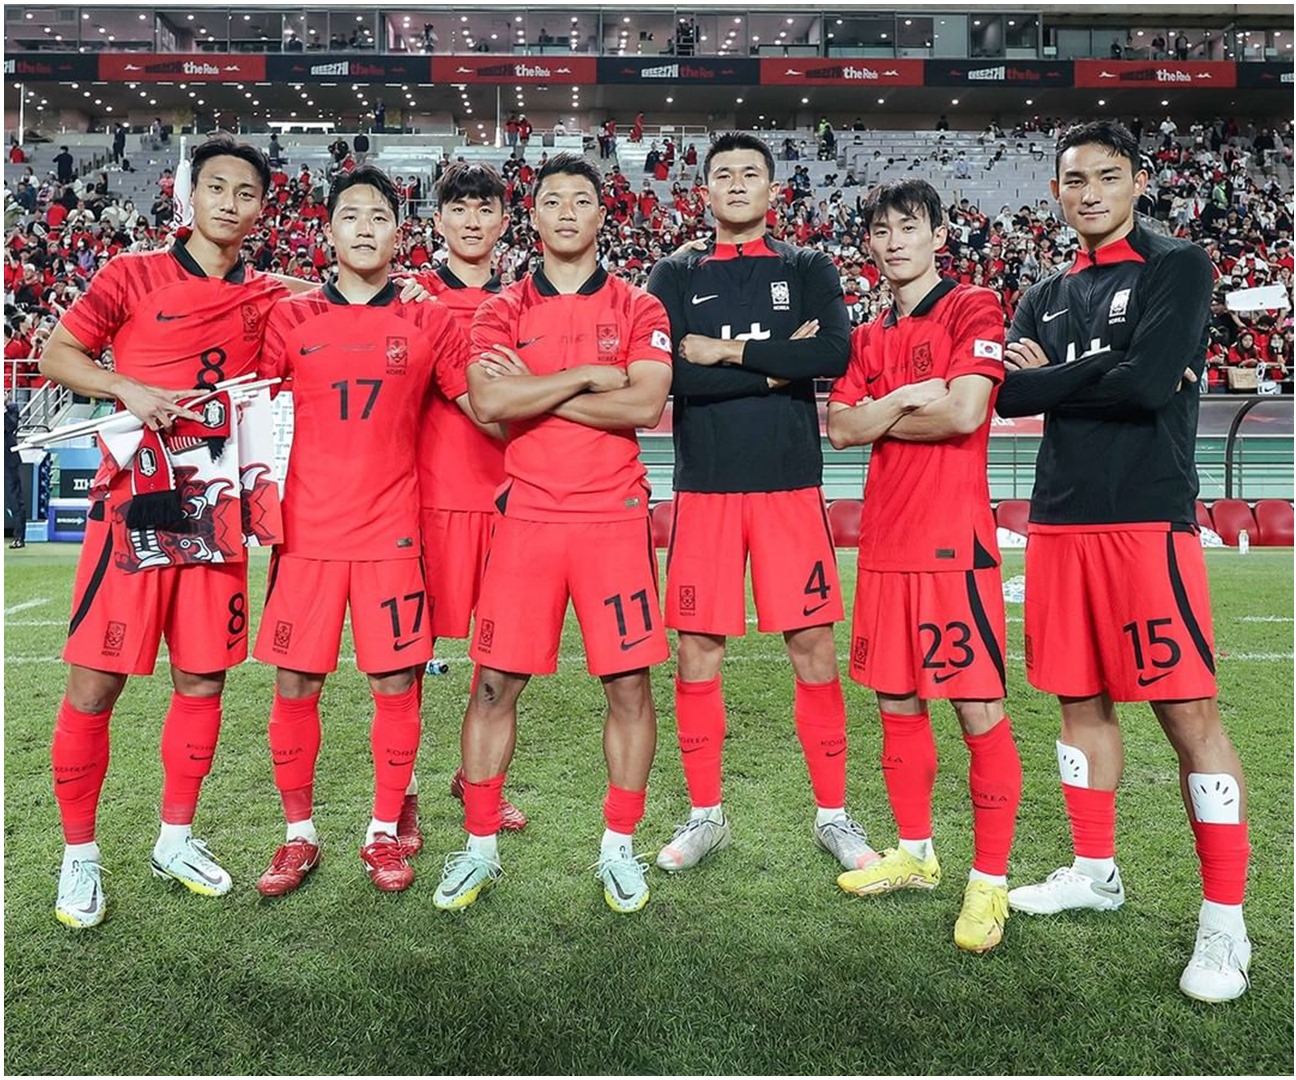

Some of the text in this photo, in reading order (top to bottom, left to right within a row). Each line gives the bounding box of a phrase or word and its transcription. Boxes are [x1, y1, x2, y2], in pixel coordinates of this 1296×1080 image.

[196, 346, 227, 392] 8
[331, 379, 384, 421] 17
[804, 560, 832, 600] 4
[227, 592, 246, 635] 8
[380, 590, 426, 638] 17
[603, 588, 653, 637] 11
[918, 621, 975, 669] 23
[1122, 617, 1182, 671] 15
